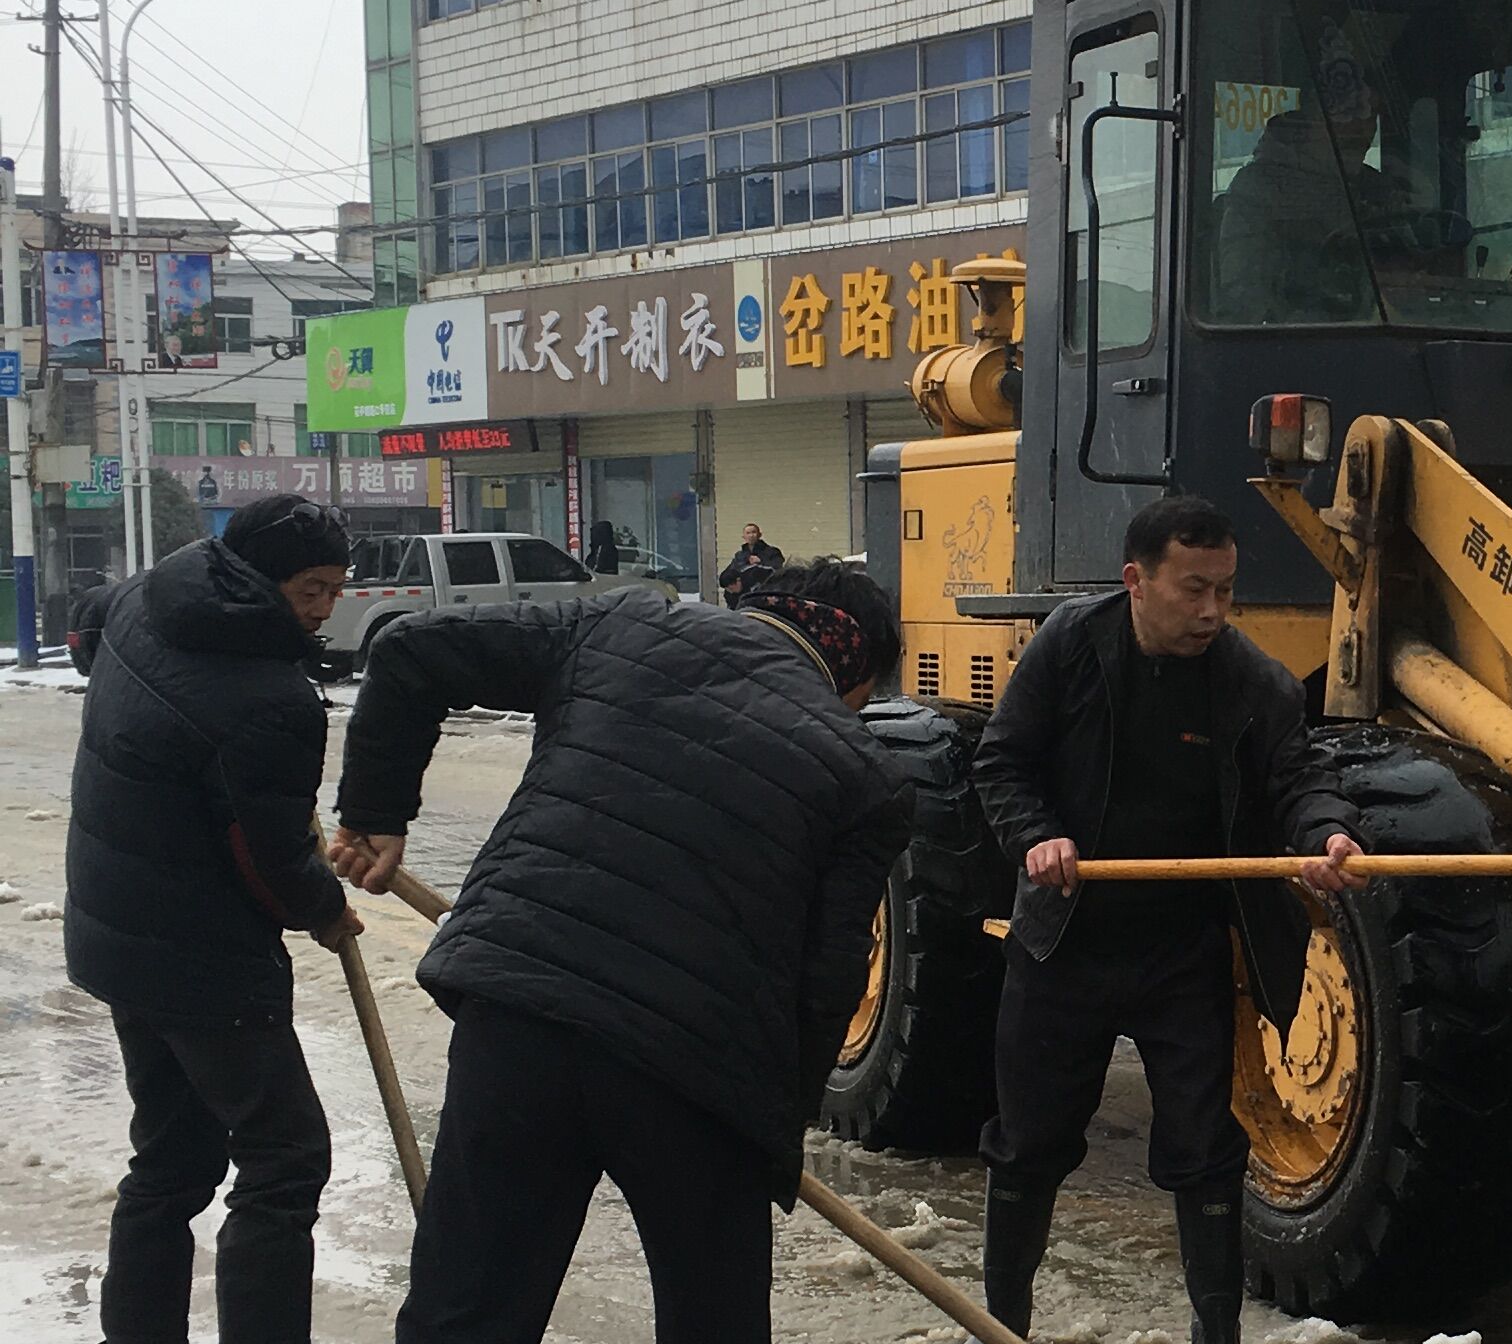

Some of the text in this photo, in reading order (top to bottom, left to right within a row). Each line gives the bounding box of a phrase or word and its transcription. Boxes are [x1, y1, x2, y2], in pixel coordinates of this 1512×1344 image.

[779, 247, 1025, 369] 岔路油
[292, 461, 418, 494] 万顺超市
